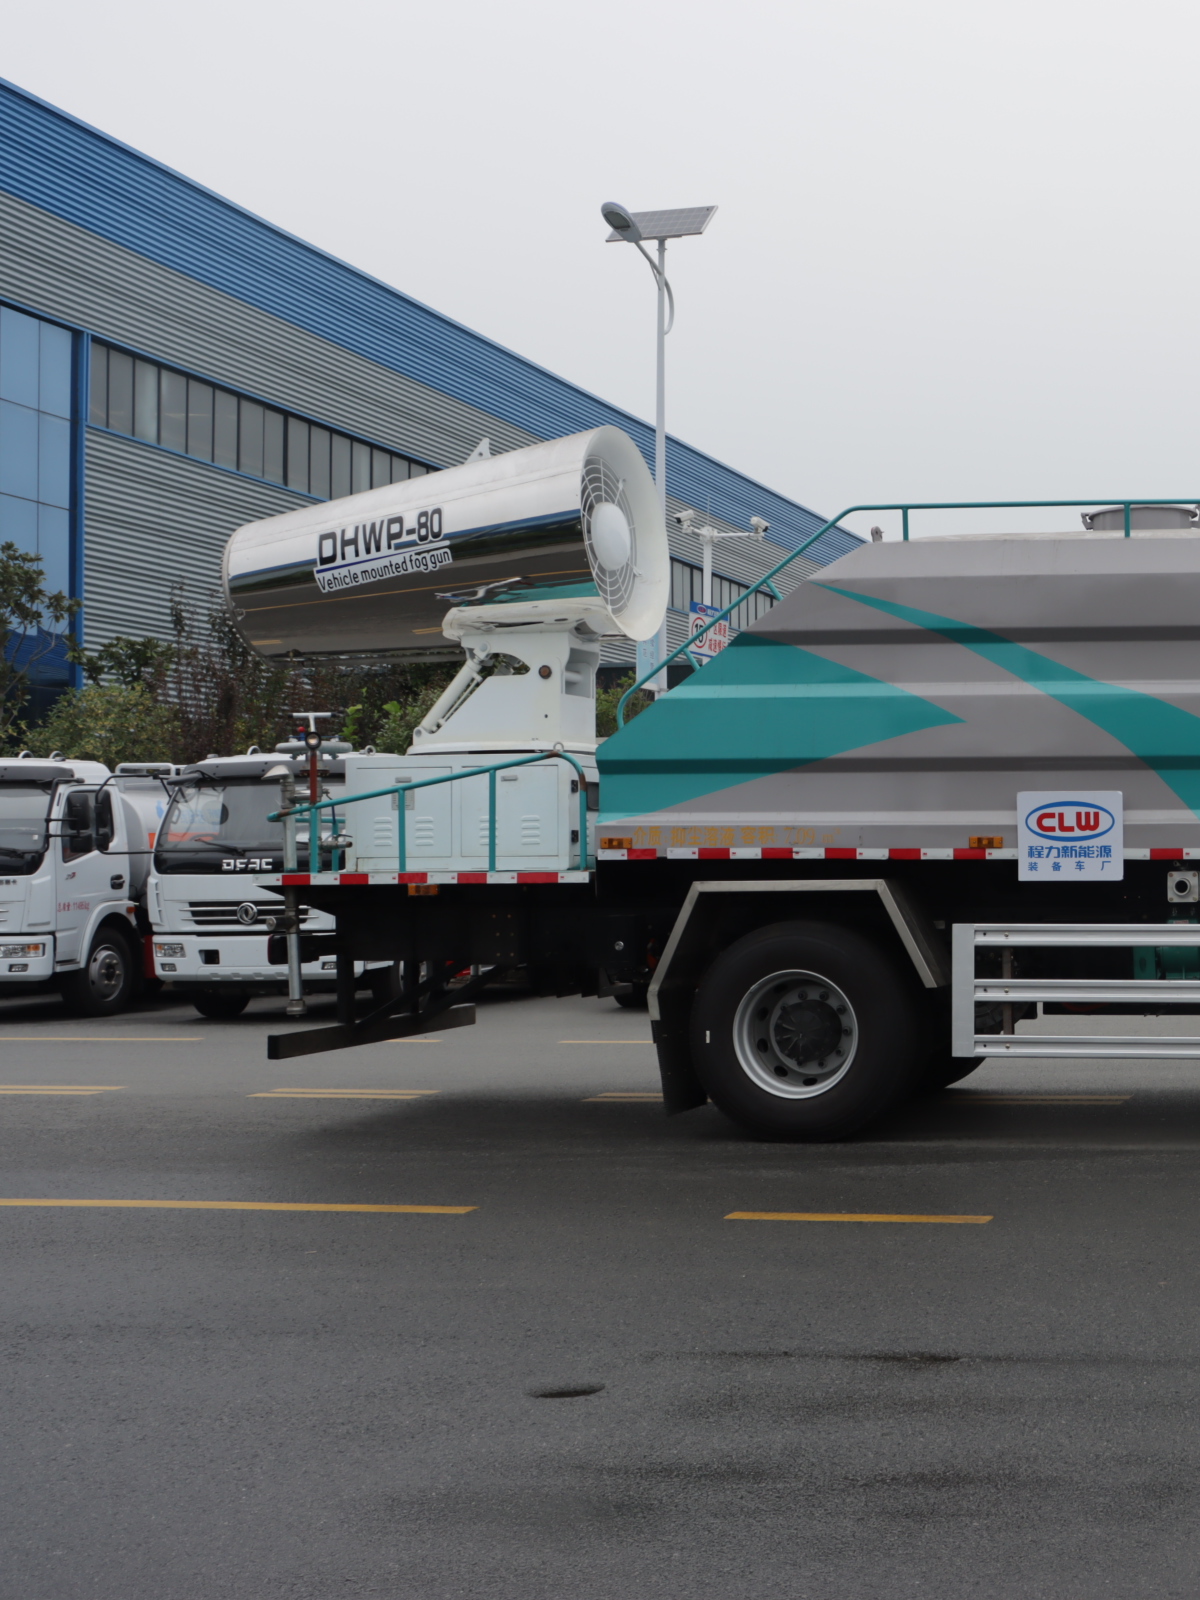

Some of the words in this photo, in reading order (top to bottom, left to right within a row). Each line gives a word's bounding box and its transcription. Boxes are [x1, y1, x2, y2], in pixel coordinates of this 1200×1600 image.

[318, 507, 443, 567] DHWP-80
[317, 569, 360, 591] Vehicle
[361, 556, 408, 582] mounted
[410, 553, 429, 571] fog
[431, 550, 451, 569] gun
[1036, 811, 1100, 832] CLW
[1027, 845, 1113, 859] 程力新能源
[222, 858, 273, 871] DFAC
[1027, 860, 1112, 872] 装备车厂
